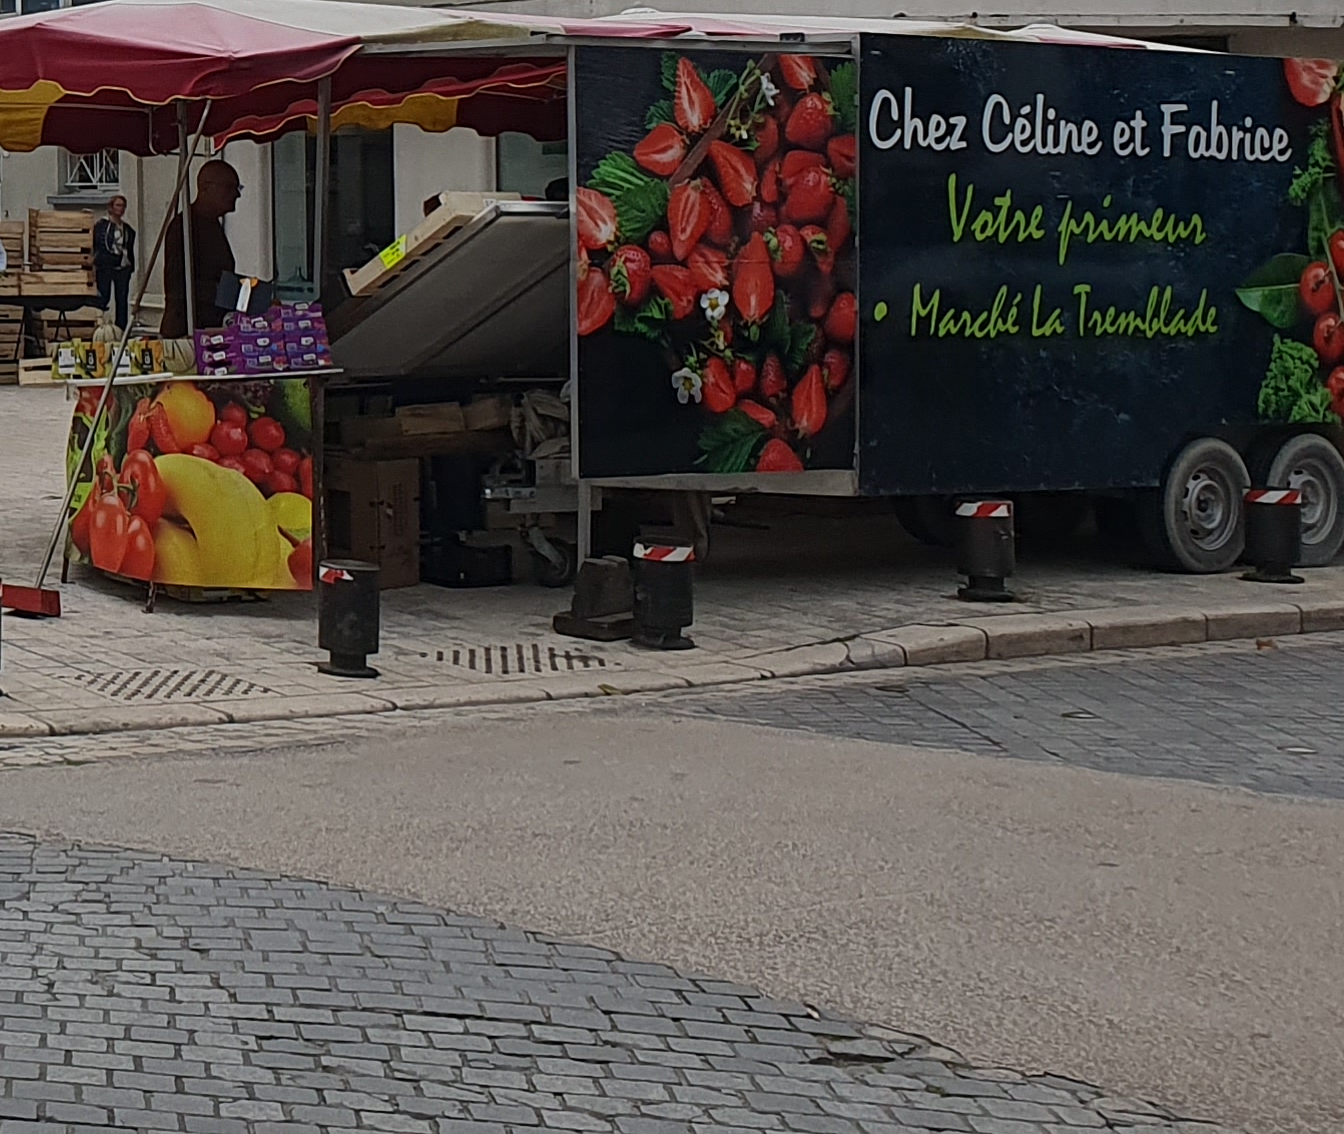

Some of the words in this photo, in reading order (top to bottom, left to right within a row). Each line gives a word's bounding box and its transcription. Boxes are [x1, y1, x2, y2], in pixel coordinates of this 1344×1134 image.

[869, 86, 968, 150] Chez
[982, 93, 1103, 155] Céline
[1114, 110, 1150, 155] et
[1160, 100, 1292, 161] Fabrice
[948, 173, 1044, 244] Votre
[1058, 194, 1206, 265] primeur
[911, 282, 1021, 338] Marché
[1032, 284, 1065, 337] La
[1074, 284, 1218, 338] Tremblade
